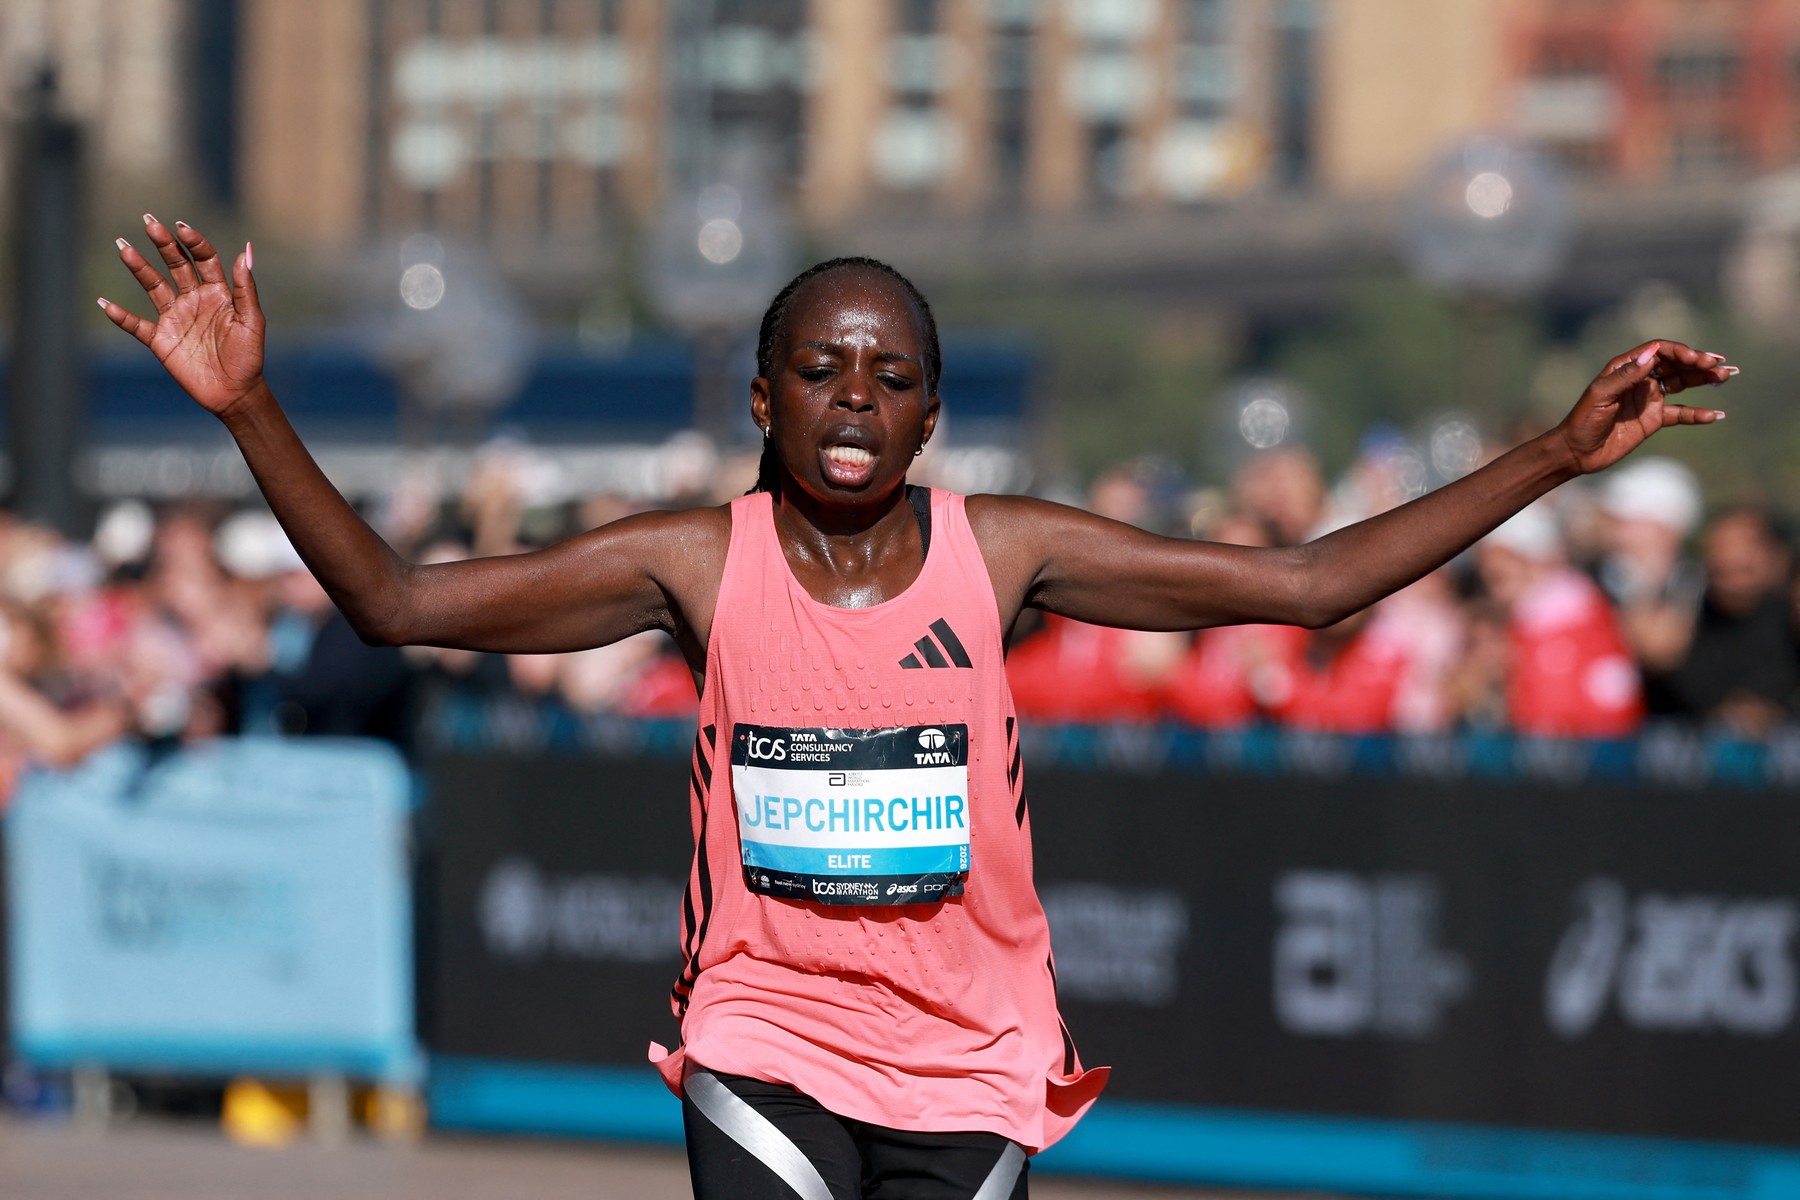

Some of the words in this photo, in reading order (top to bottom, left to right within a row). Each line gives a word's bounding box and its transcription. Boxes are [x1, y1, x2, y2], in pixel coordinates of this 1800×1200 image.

[790, 734, 817, 742] TATA
[749, 730, 786, 761] tcs
[790, 743, 853, 752] CONSULTANCY
[790, 754, 831, 762] SERVICES
[914, 752, 951, 765] TATA
[744, 794, 965, 833] JEPCHIRCHIR
[827, 854, 872, 869] ELITE
[812, 878, 836, 895] tcs
[836, 882, 864, 890] SYDNEY
[896, 884, 918, 893] asics
